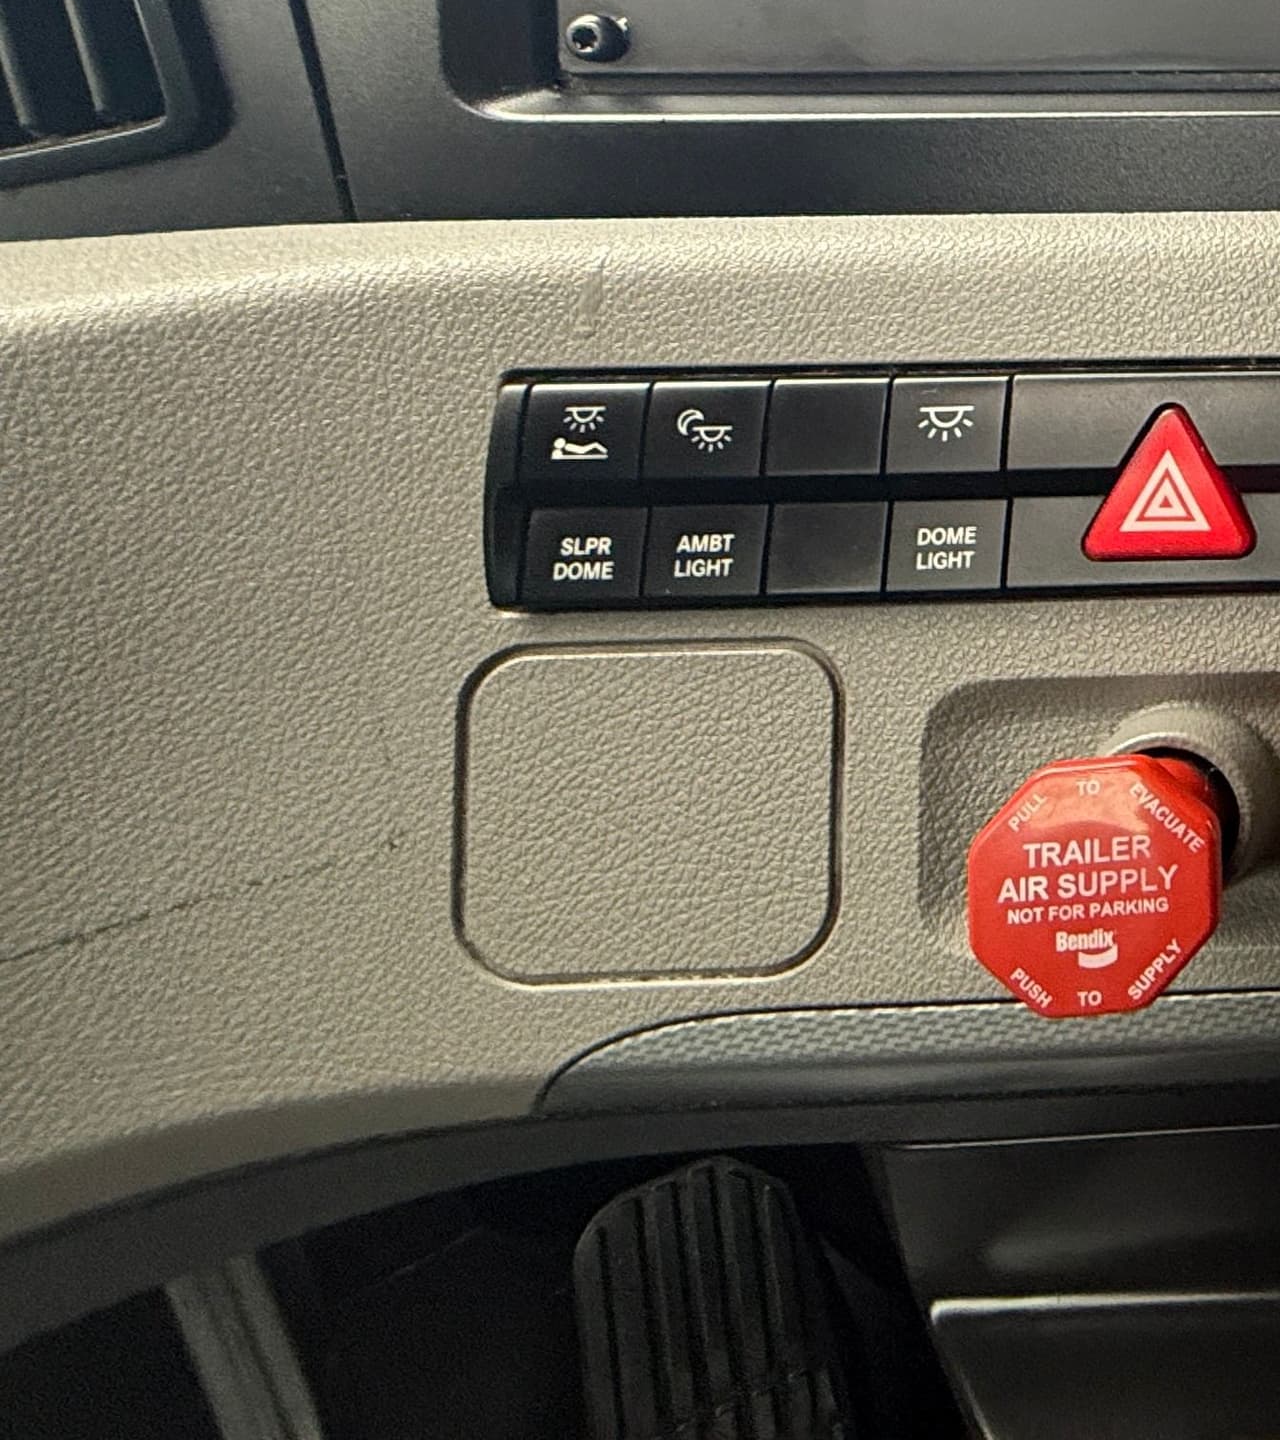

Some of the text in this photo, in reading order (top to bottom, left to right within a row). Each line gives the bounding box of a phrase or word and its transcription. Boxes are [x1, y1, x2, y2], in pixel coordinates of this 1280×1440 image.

[560, 536, 612, 557] SLPR
[676, 533, 735, 554] AMBT
[916, 526, 977, 547] DOME
[552, 559, 614, 581] DOME
[674, 557, 734, 578] LIGHT
[915, 549, 975, 570] LIGHT
[1007, 779, 1206, 854] PULL TO EVACUATE
[1023, 834, 1152, 869] TRAILER
[997, 864, 1179, 904] AIR SUPPLY
[1007, 896, 1169, 925] NOT FOR PARKING
[1055, 928, 1116, 952] Bendix
[1009, 938, 1183, 1009] PUSH TO SUPPLY
